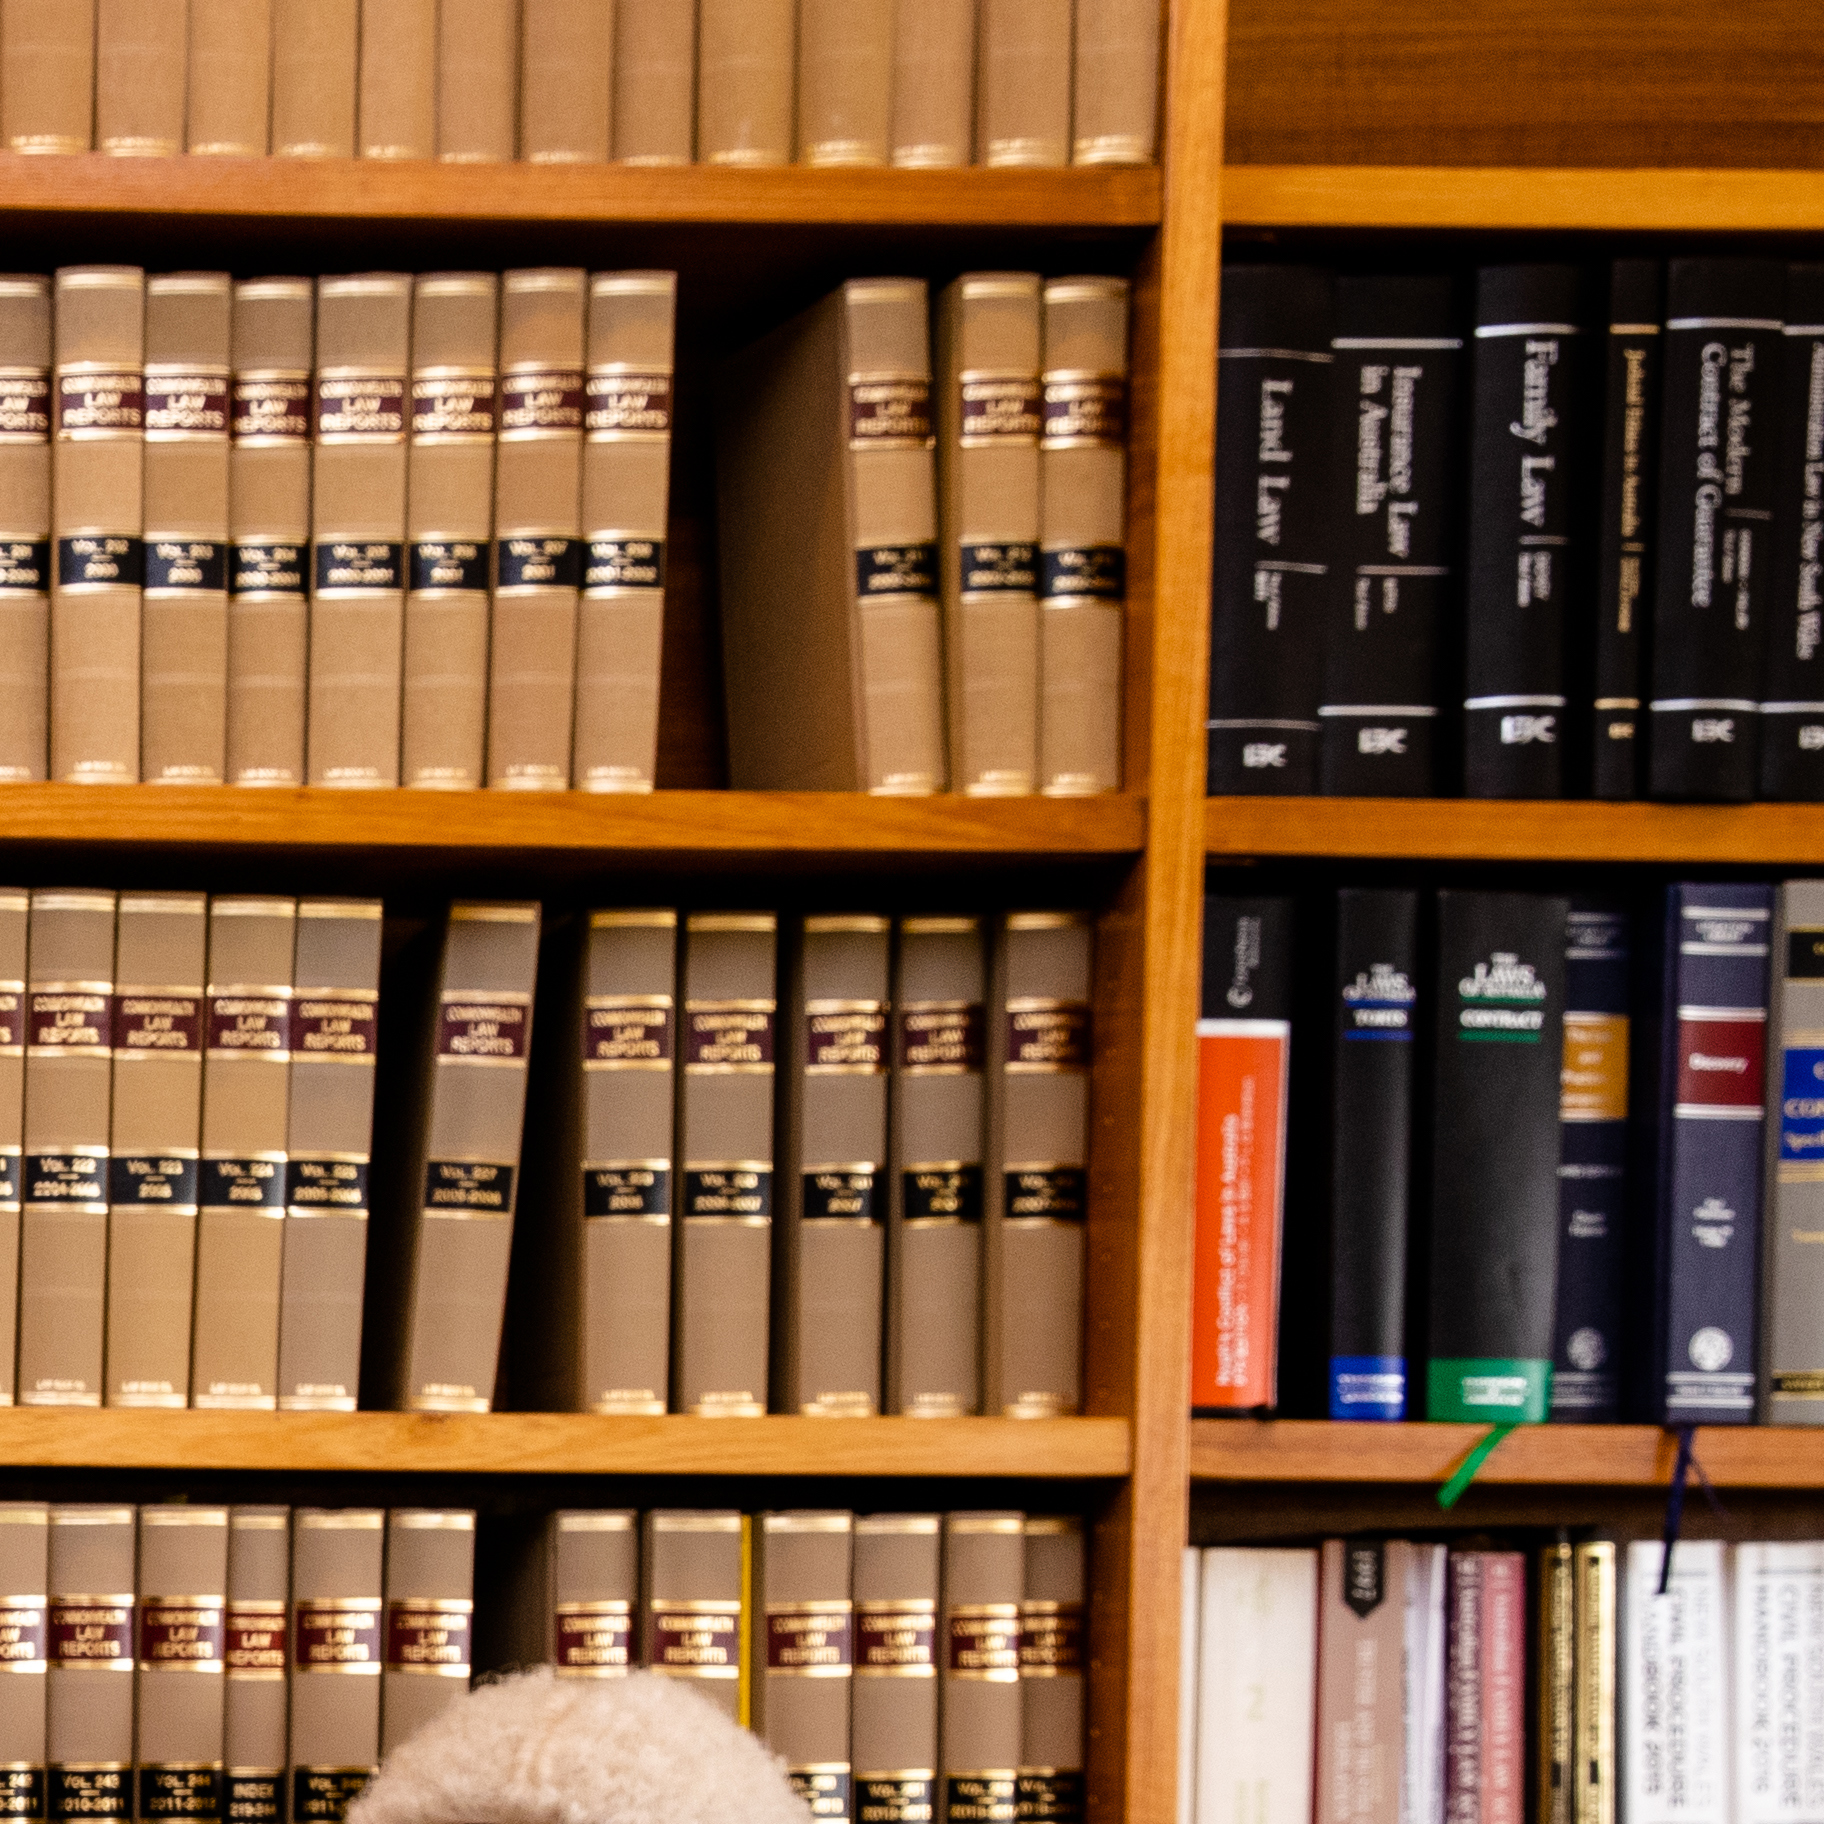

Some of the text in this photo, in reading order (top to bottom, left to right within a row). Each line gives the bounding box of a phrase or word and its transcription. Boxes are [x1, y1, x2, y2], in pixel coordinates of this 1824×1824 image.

[1257, 380, 1294, 545] Land Law
[1388, 366, 1423, 557] Insurance Law
[1510, 340, 1558, 527] Family Law
[1696, 453, 1724, 482] of
[1698, 342, 1728, 448] Contract
[1725, 343, 1754, 495] The Modern
[1460, 1009, 1543, 1029] CONTRACT
